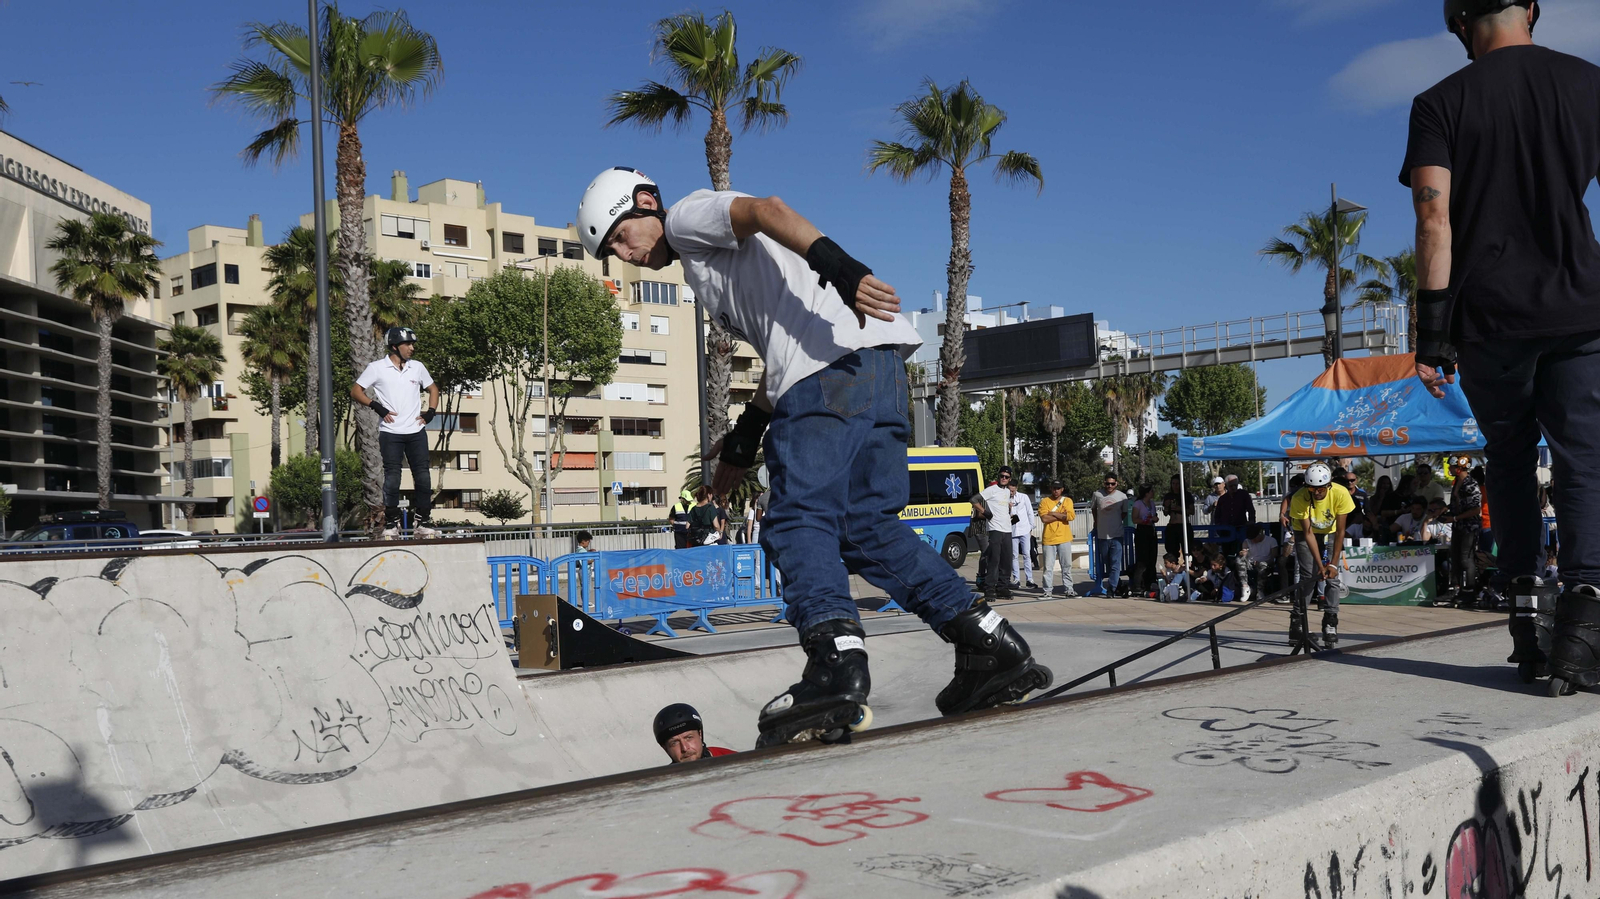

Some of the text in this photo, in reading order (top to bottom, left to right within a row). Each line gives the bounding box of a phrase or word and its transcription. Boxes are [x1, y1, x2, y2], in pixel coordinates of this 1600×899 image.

[58, 182, 68, 200] Y
[901, 506, 953, 518] AMBULANCIA
[1366, 547, 1431, 562] FREESTYLE
[1349, 564, 1419, 574] CAMPEONATO
[609, 567, 704, 598] deportes
[1356, 575, 1404, 584] ANDALUZ
